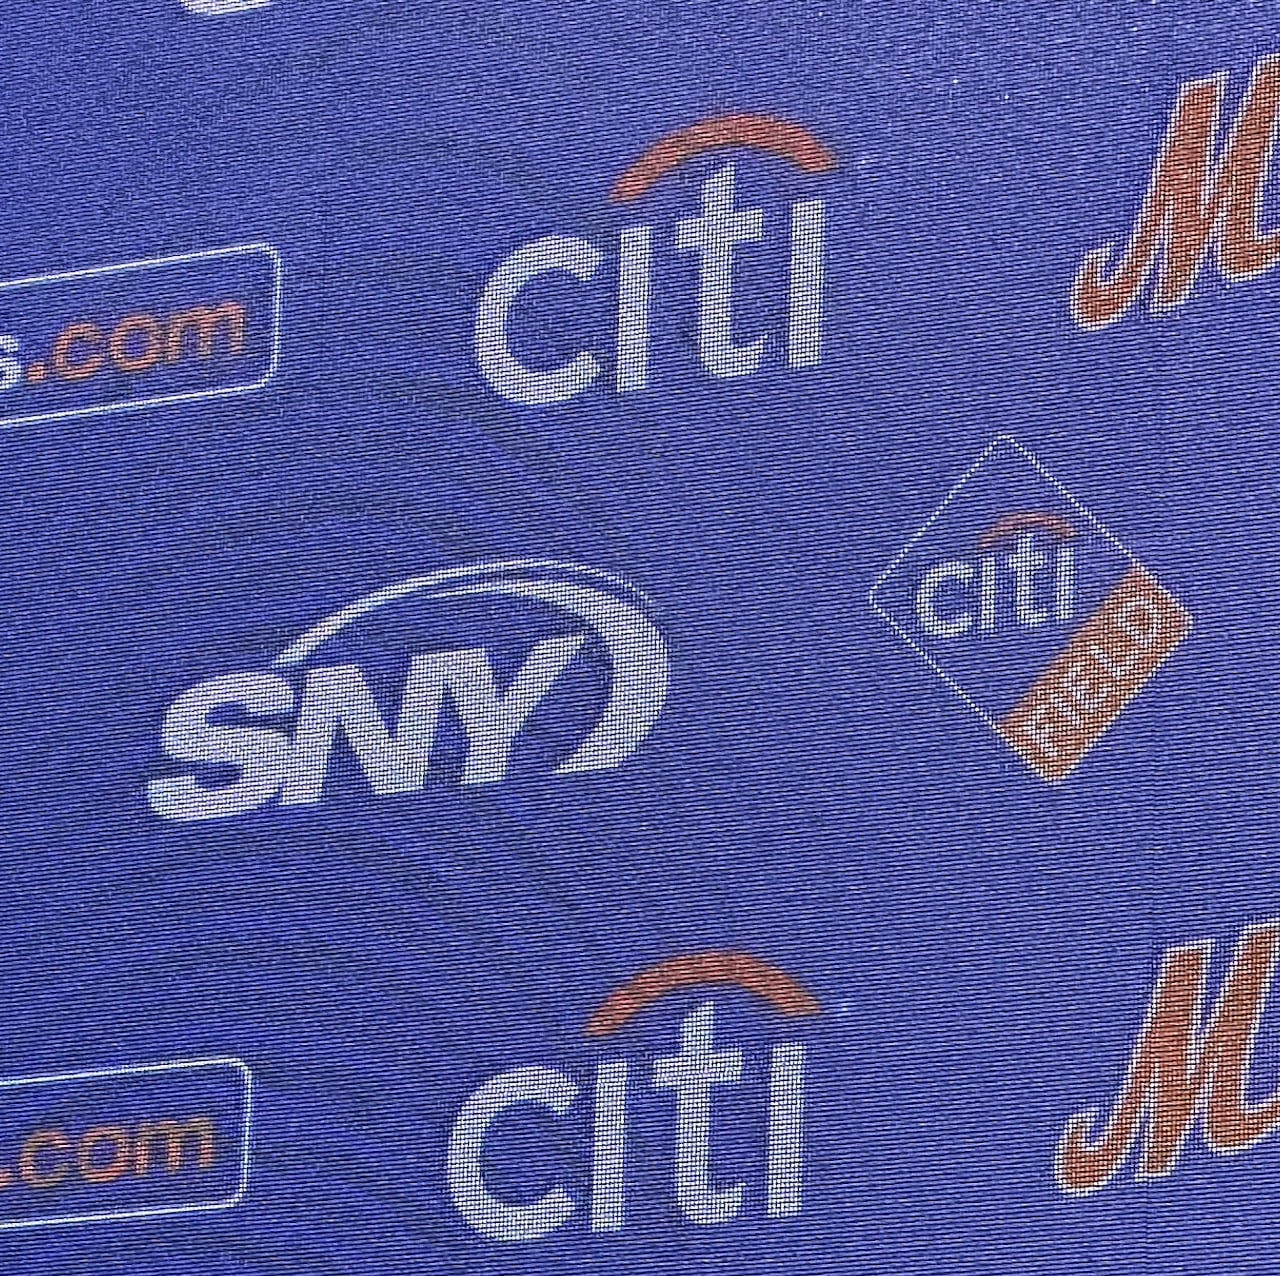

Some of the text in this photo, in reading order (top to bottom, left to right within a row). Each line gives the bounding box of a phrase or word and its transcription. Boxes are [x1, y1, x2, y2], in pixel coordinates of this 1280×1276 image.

[474, 162, 825, 404] citi
[915, 531, 1075, 638] citi
[1024, 596, 1160, 758] FIELD
[147, 633, 586, 822] SNY
[446, 1000, 806, 1242] citi
